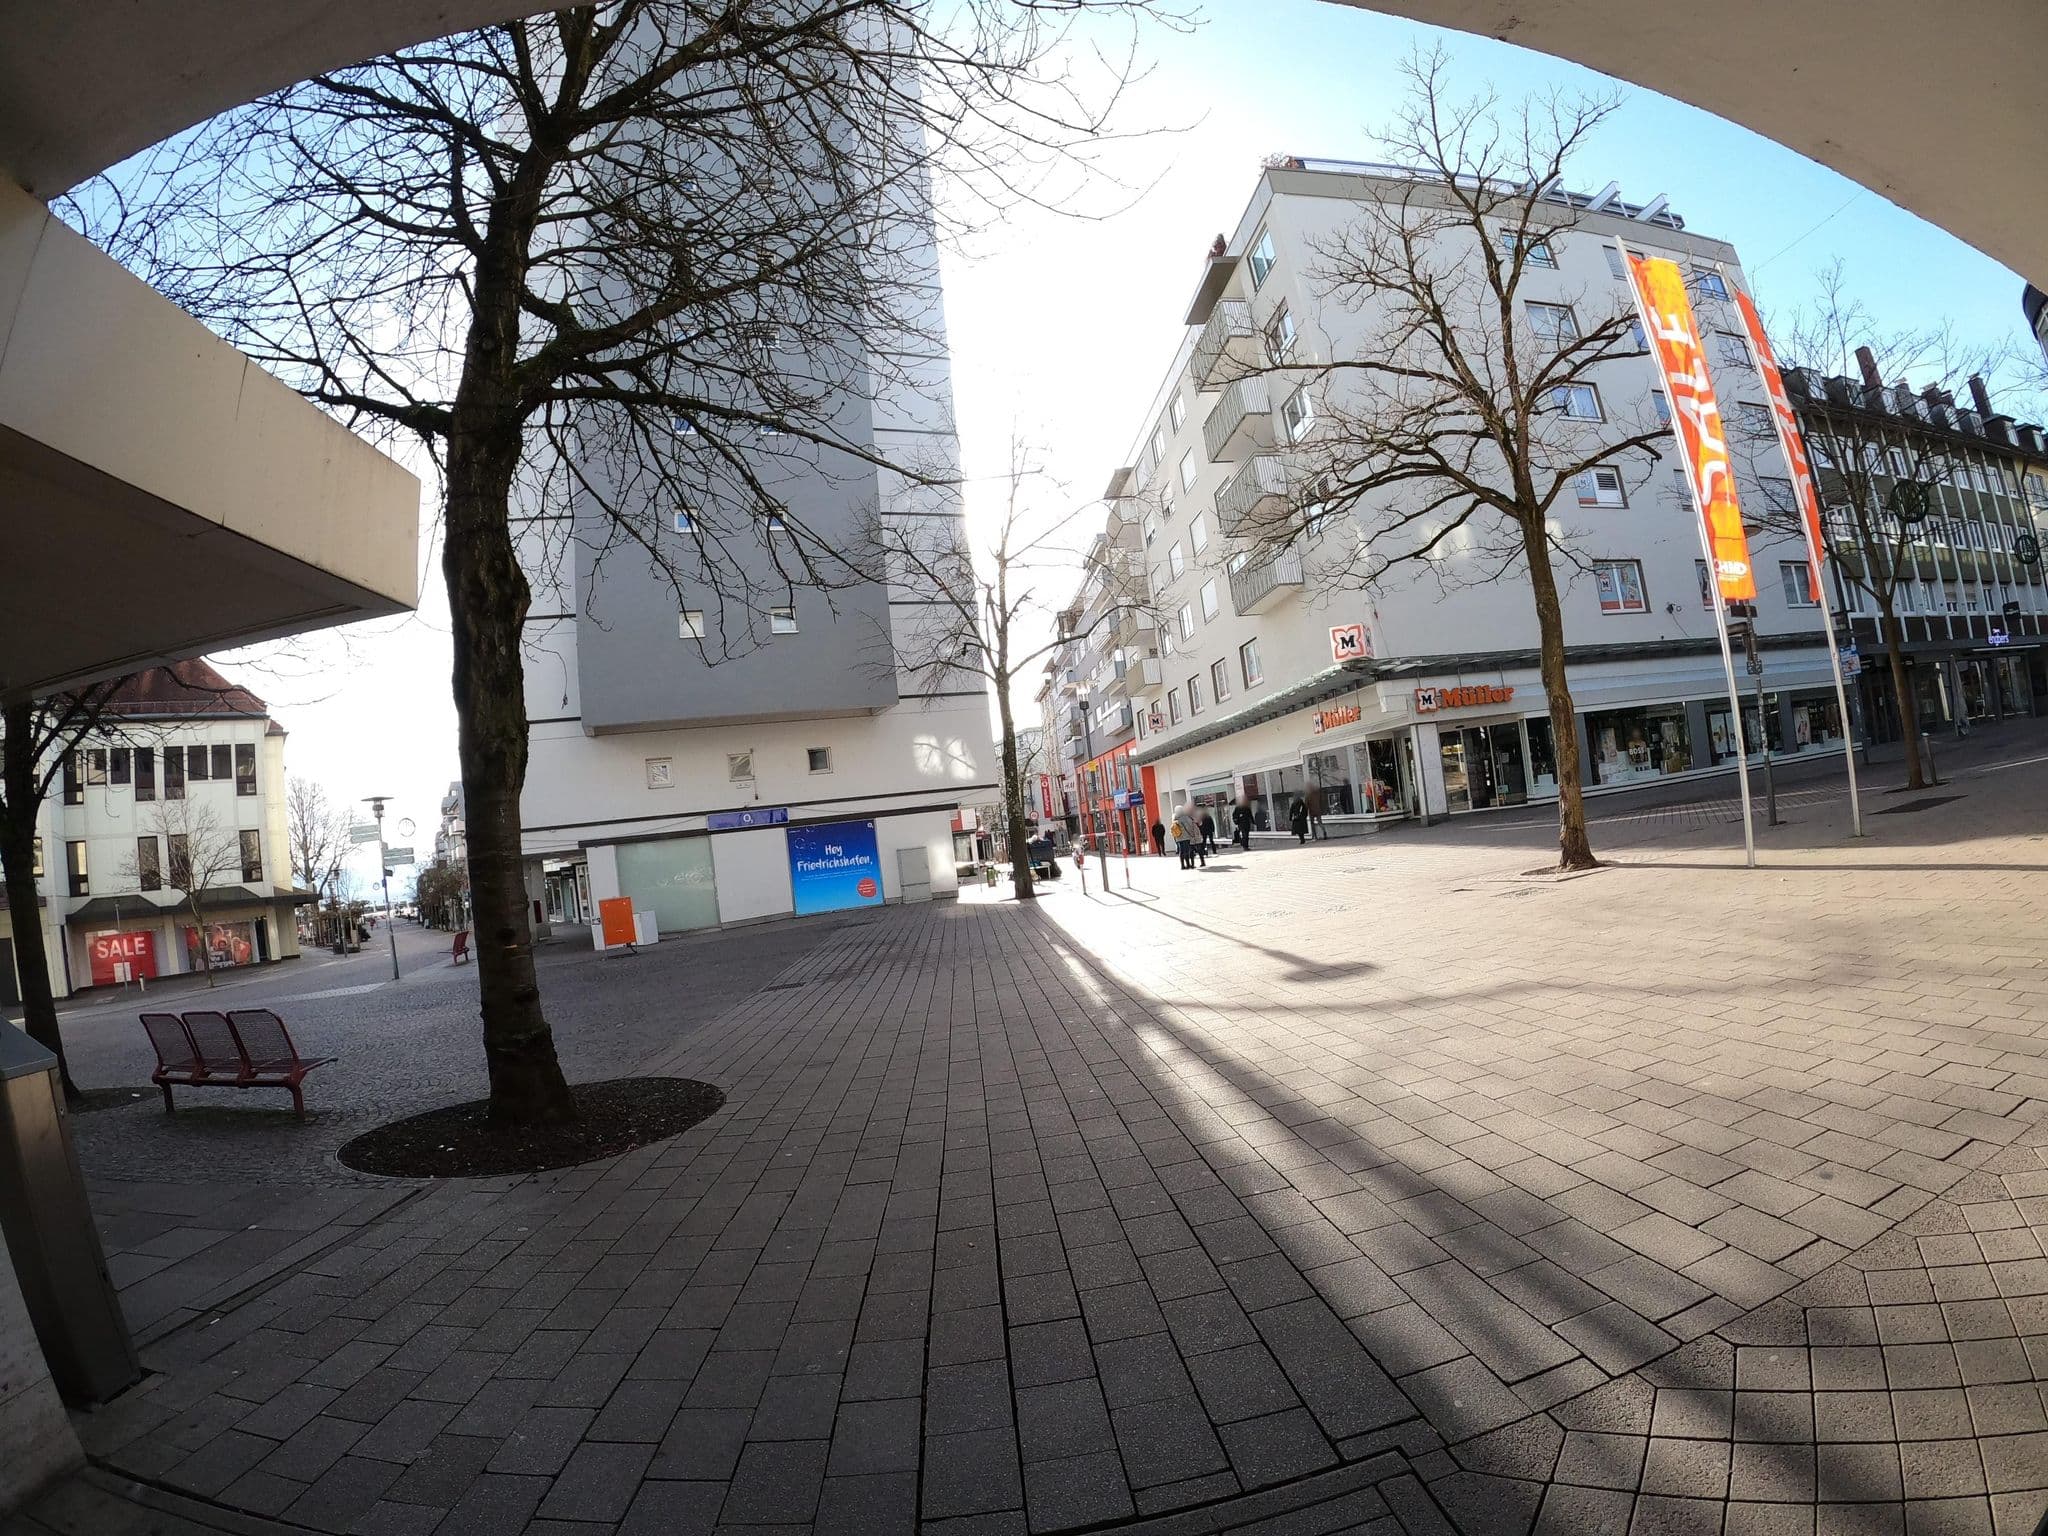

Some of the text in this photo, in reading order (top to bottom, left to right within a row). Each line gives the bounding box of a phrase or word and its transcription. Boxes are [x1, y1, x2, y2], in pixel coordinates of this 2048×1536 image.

[1649, 305, 1731, 507] SALE
[1340, 634, 1356, 650] M
[1421, 685, 1515, 709] M Müller
[1323, 705, 1362, 730] Müller
[825, 844, 842, 857] Hey
[97, 936, 147, 959] SALE
